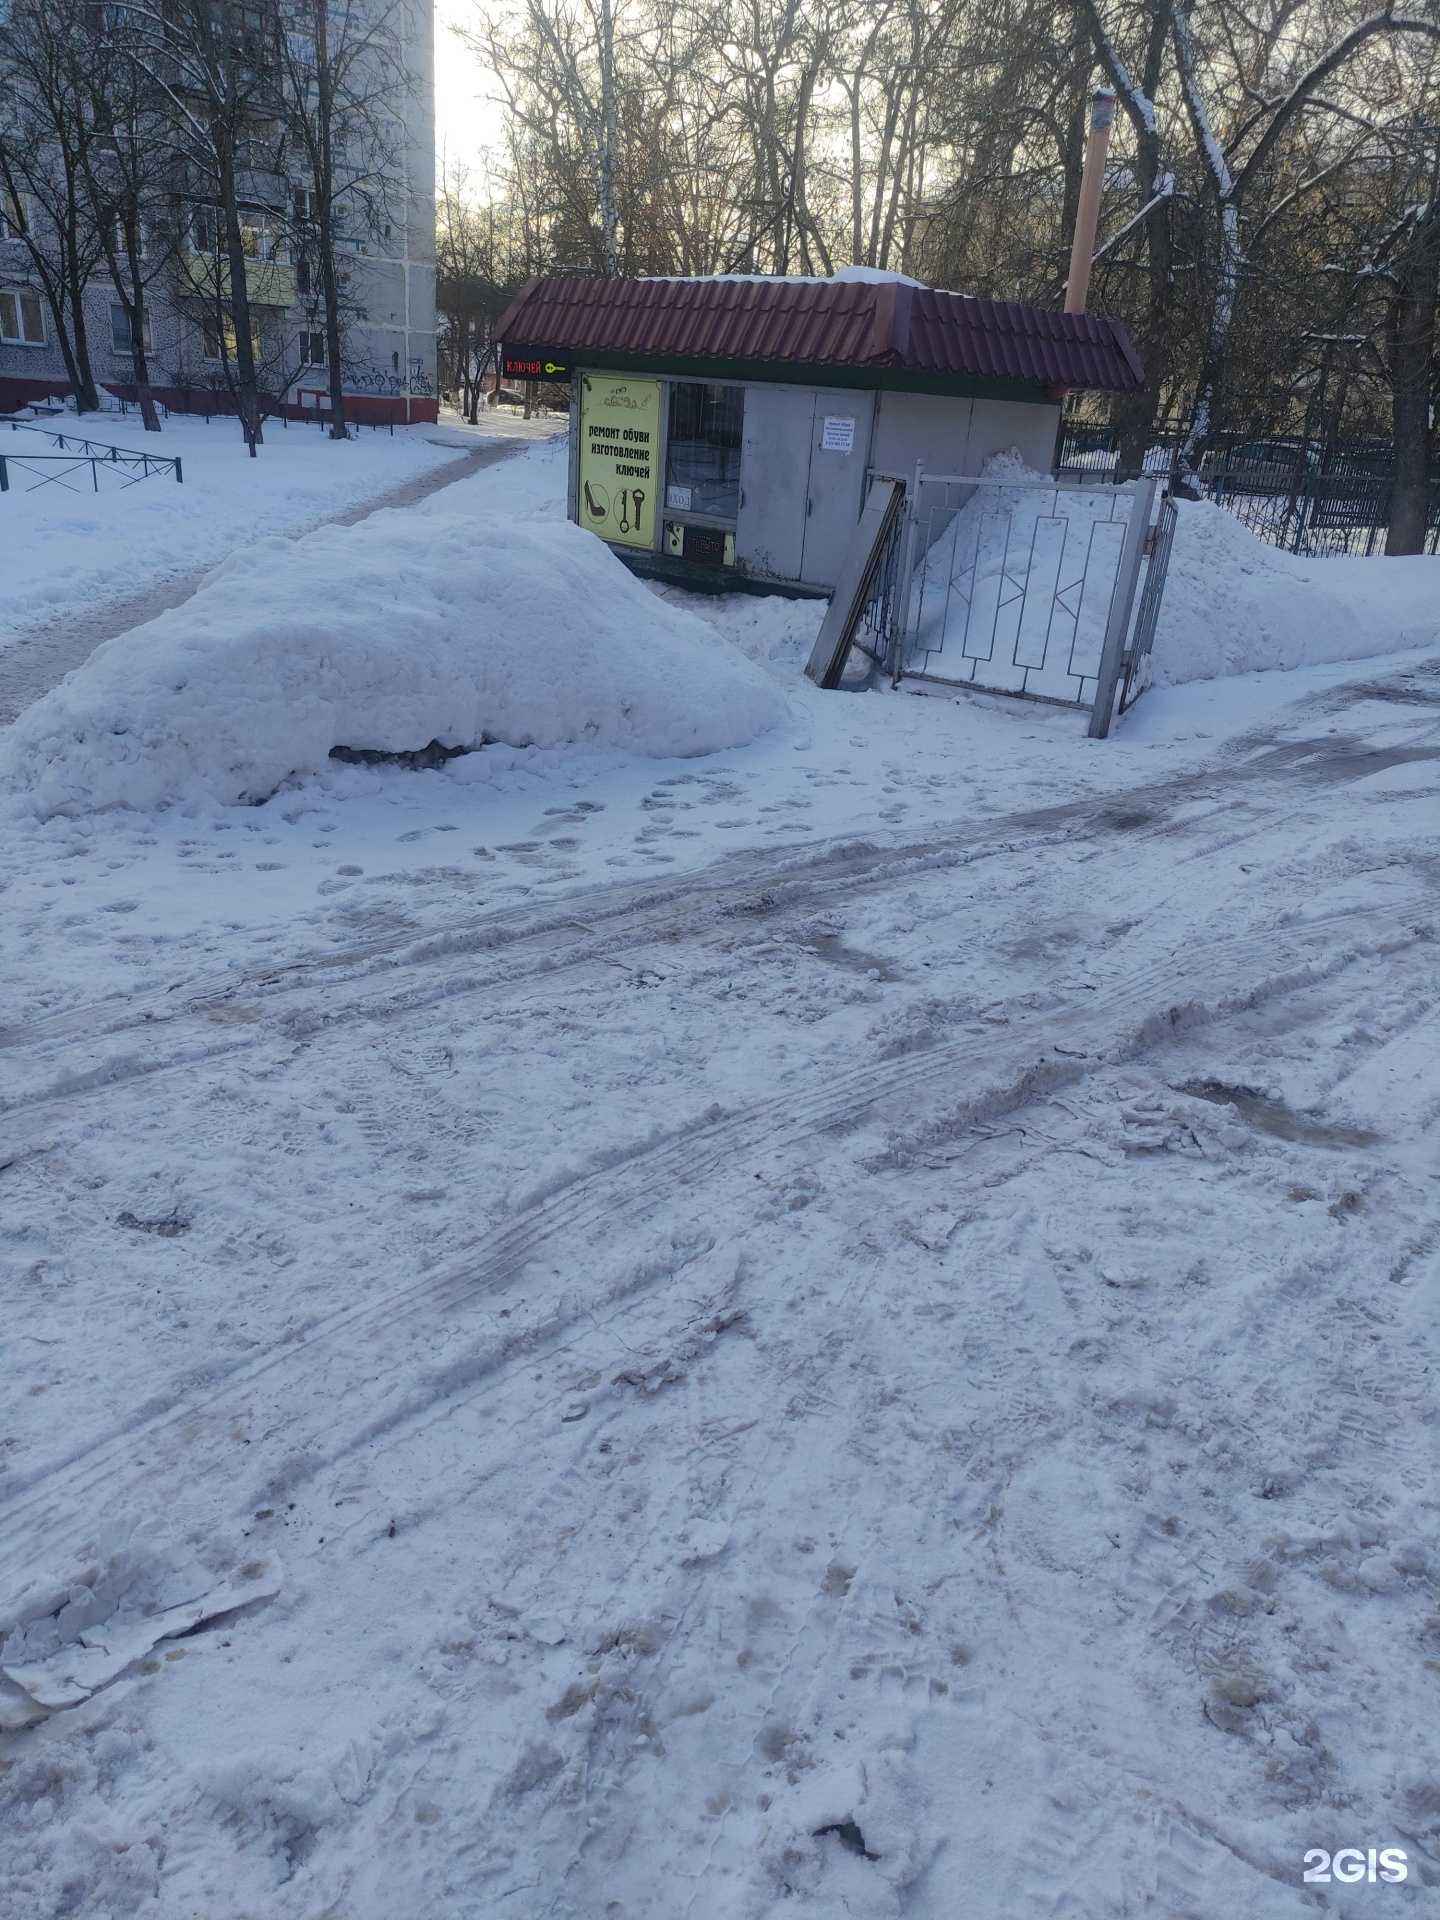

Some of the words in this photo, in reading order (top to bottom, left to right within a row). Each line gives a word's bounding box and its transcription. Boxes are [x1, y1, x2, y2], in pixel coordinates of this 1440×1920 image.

[506, 360, 541, 374] КЛЮЧЕЙ
[588, 425, 620, 439] ремонт
[623, 428, 650, 443] обуви
[591, 443, 650, 461] изготовление
[615, 464, 650, 479] ключей
